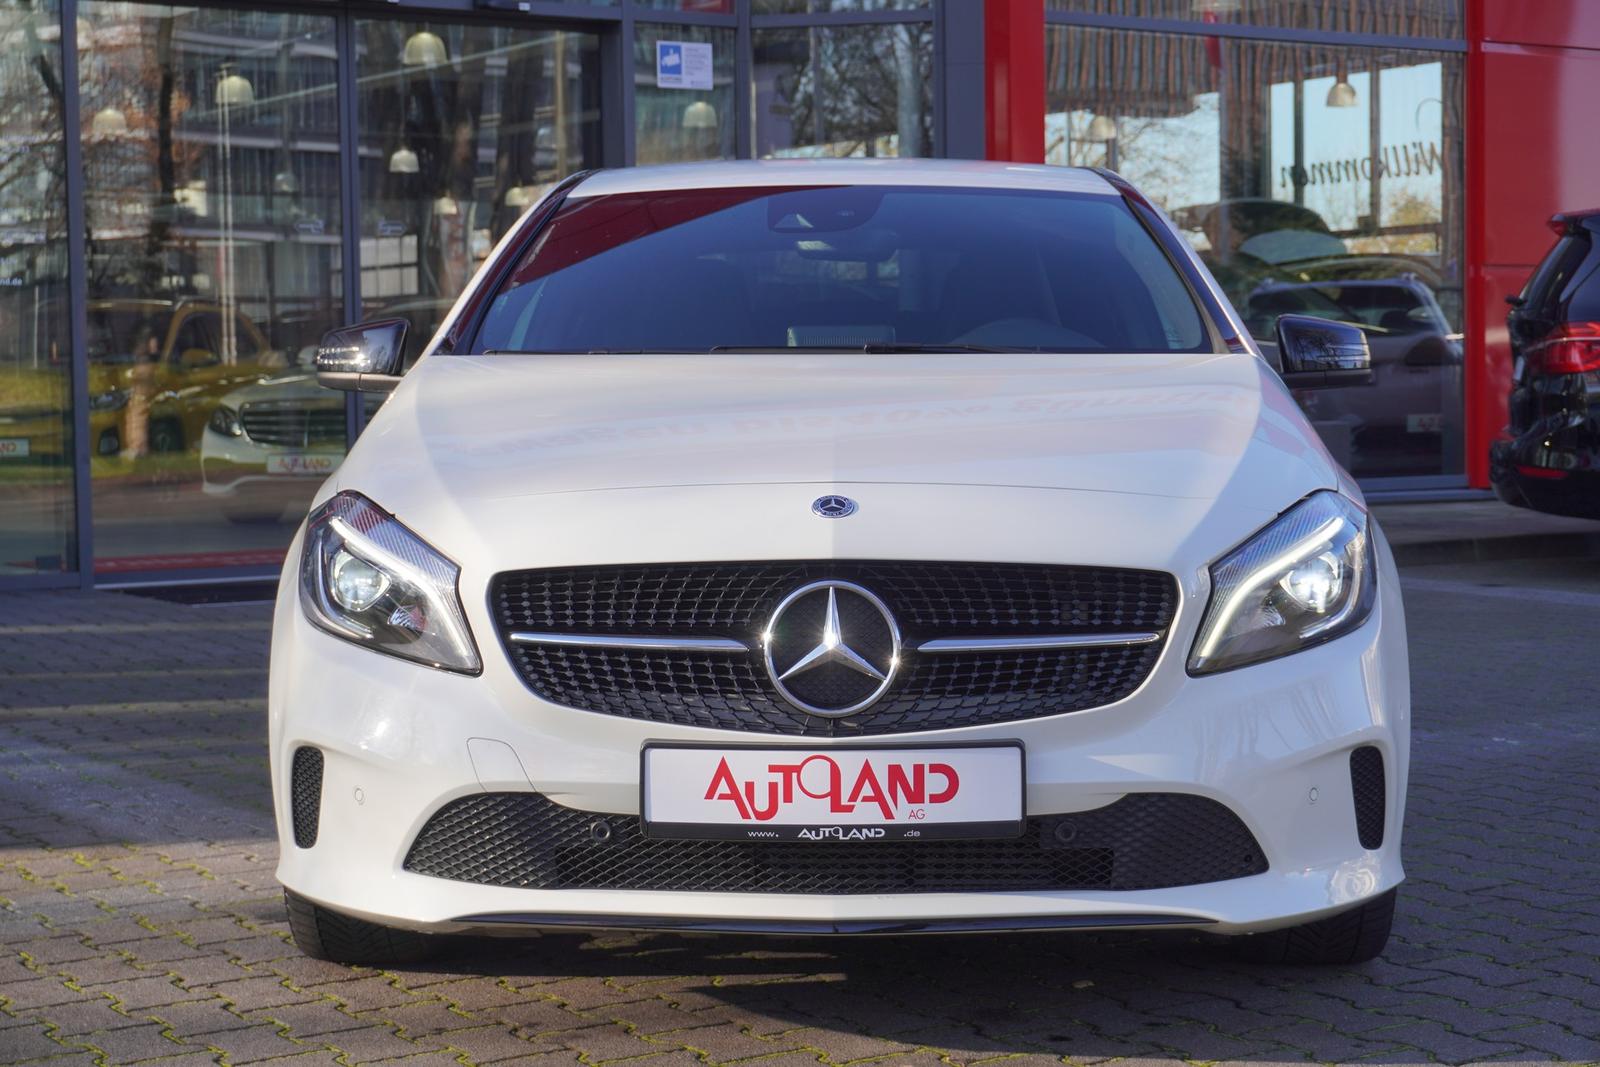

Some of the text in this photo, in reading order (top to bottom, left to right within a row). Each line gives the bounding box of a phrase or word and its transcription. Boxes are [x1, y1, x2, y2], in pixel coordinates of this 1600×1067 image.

[704, 754, 960, 821] AUTOLAND
[908, 809, 925, 820] AG
[797, 826, 886, 841] AUTOLAND
[903, 830, 920, 838] .de
